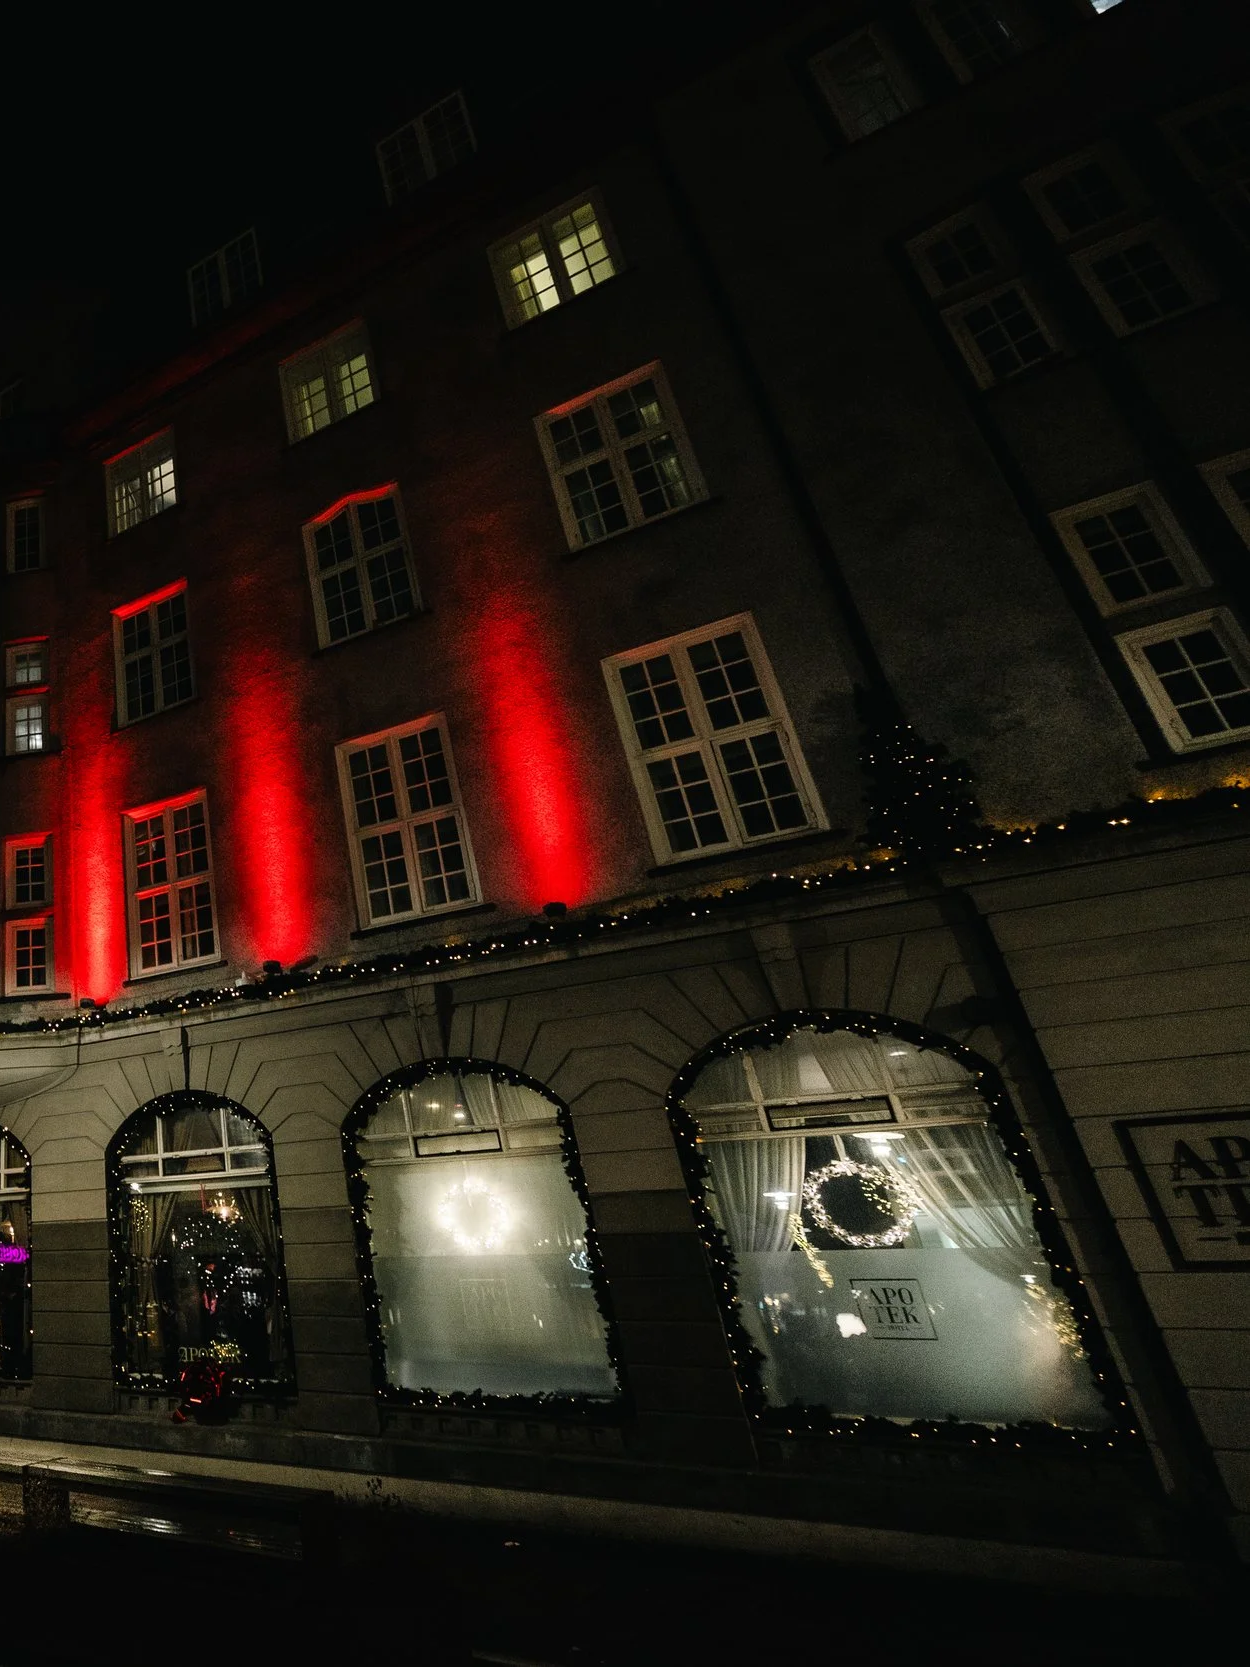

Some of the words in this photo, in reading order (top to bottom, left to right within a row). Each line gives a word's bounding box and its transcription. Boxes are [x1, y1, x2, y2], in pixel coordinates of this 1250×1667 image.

[869, 1287, 914, 1306] APO
[869, 1306, 922, 1324] TEK
[177, 1346, 242, 1364] APOEK
